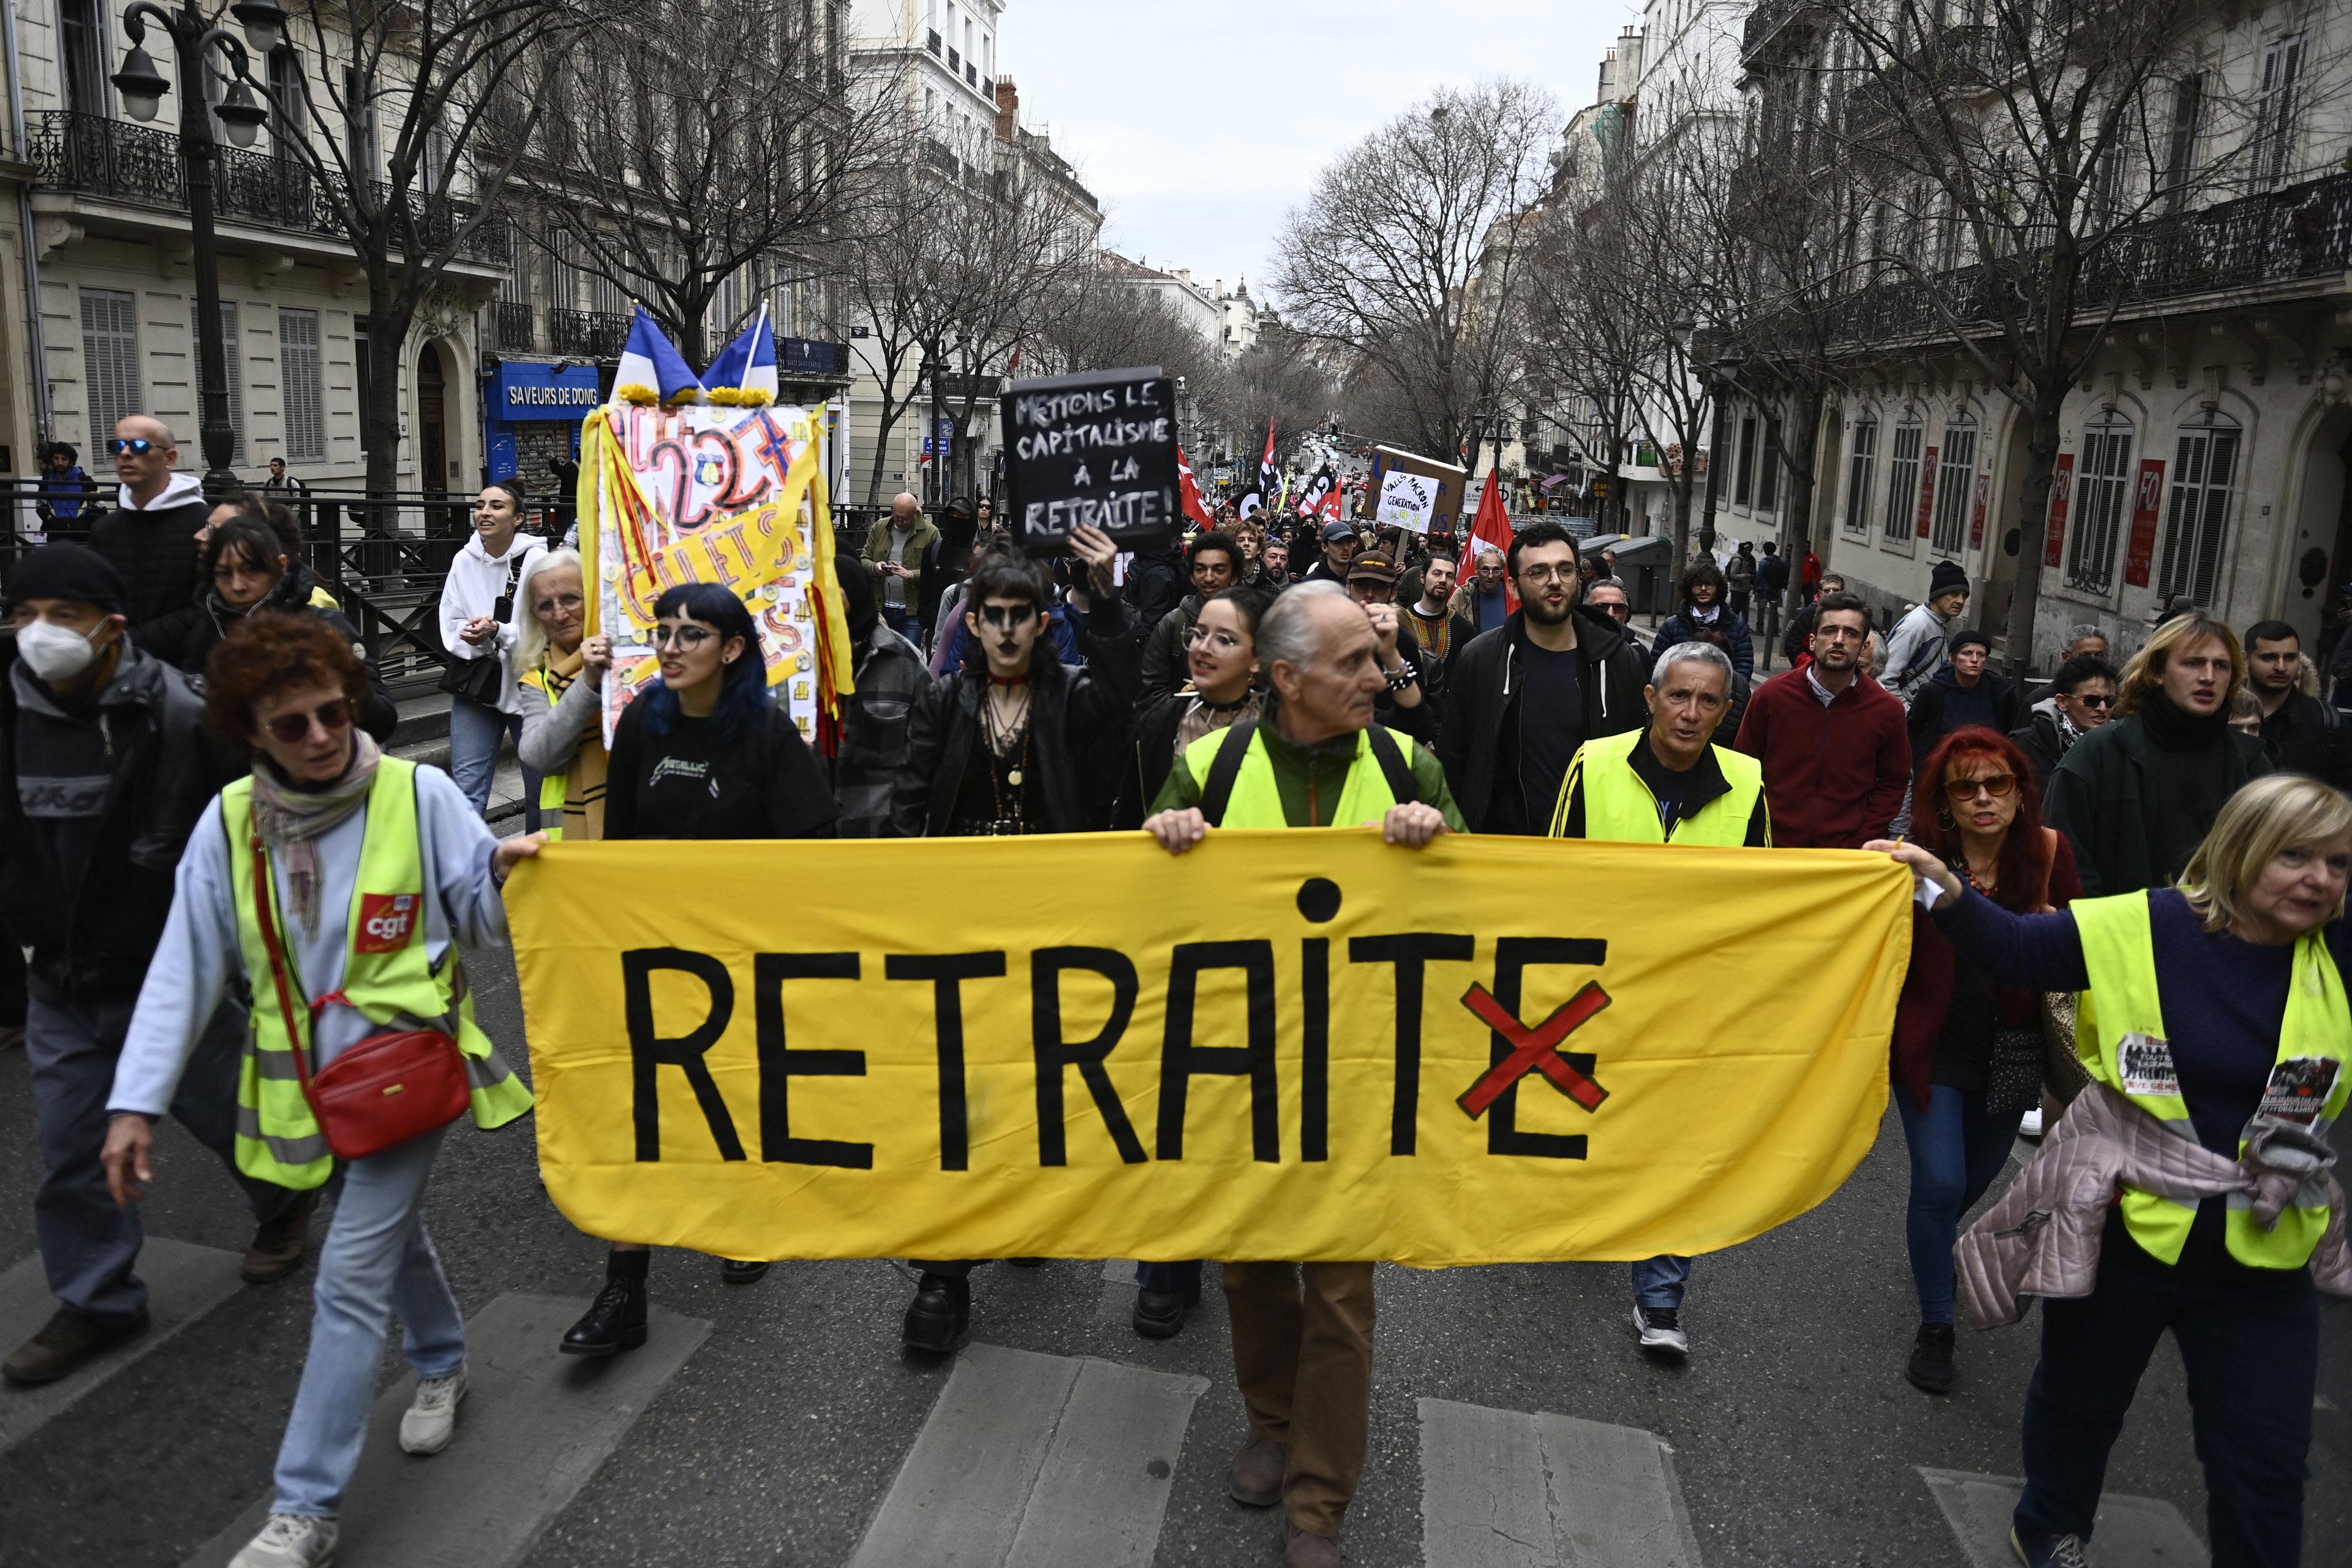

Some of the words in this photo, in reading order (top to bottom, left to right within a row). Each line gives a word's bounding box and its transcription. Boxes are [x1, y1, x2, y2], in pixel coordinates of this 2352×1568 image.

[510, 386, 557, 405] SAVEURS
[558, 386, 570, 405] DE
[571, 387, 597, 405] DONG
[1015, 389, 1117, 428] METTONS
[1125, 381, 1159, 407] LE
[1109, 456, 1140, 481] LA
[1383, 473, 1407, 492] VALLS
[1407, 475, 1430, 510] MACRON
[1390, 508, 1420, 531] 49.3
[366, 913, 409, 940] cgt
